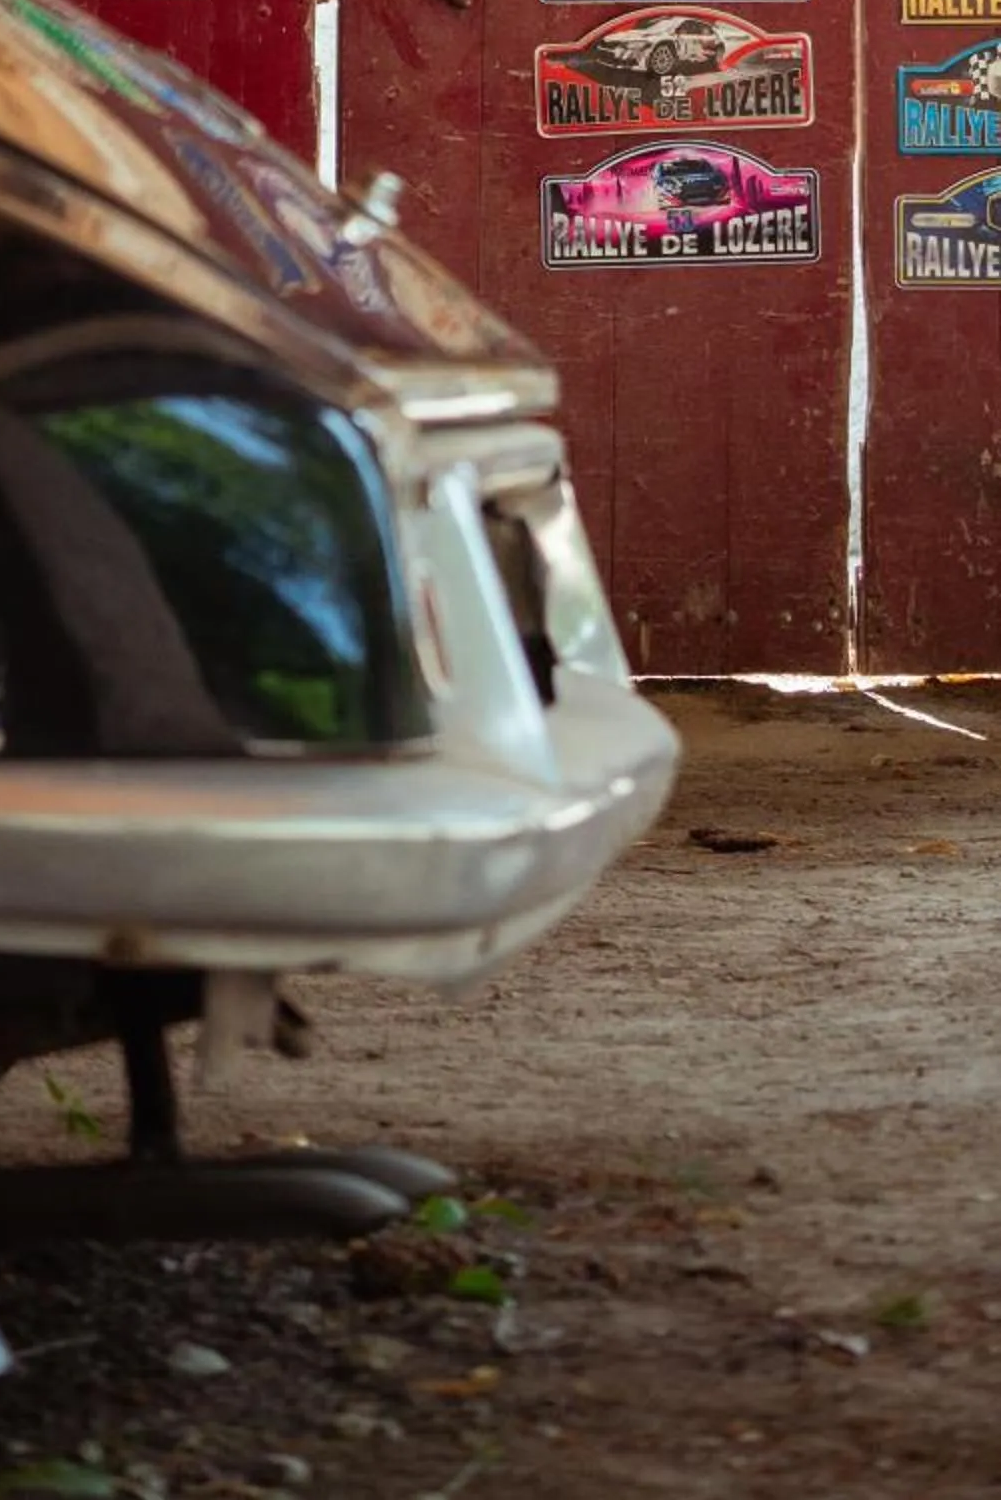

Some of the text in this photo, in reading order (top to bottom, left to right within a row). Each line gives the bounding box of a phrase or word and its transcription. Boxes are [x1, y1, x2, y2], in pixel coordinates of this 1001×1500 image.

[545, 68, 804, 125] RALLYE DE LOZERE
[660, 75, 687, 97] 52
[904, 98, 1001, 147] RALLYE
[552, 204, 809, 258] RALLYE DE LOZERE
[906, 231, 1000, 278] RALLYE
